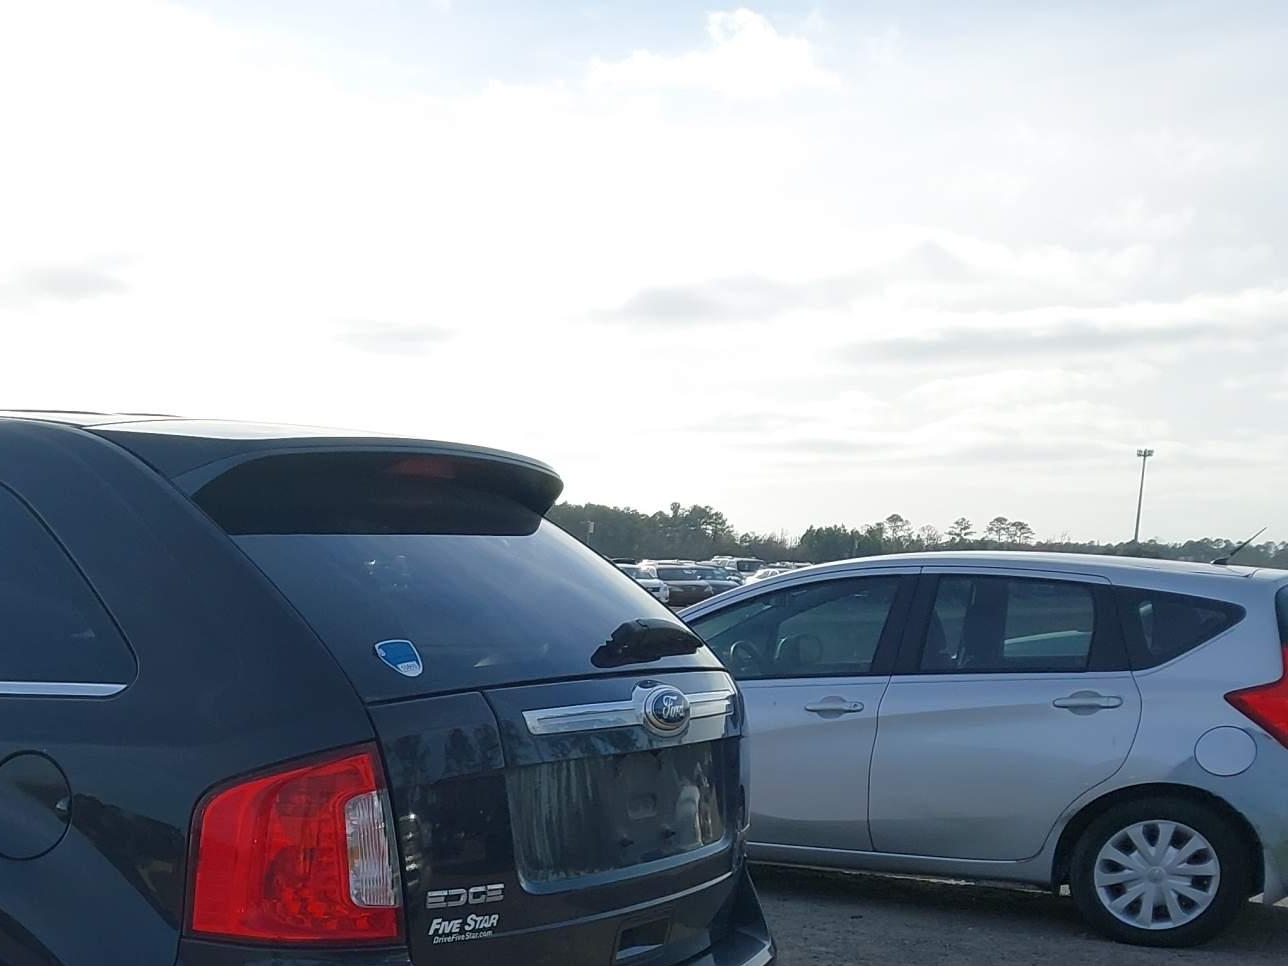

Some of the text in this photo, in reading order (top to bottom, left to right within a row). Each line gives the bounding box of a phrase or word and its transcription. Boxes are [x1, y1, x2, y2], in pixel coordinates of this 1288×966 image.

[662, 695, 684, 719] Ford
[426, 883, 505, 909] EDGE
[433, 930, 493, 945] DriveFiveStar.com
